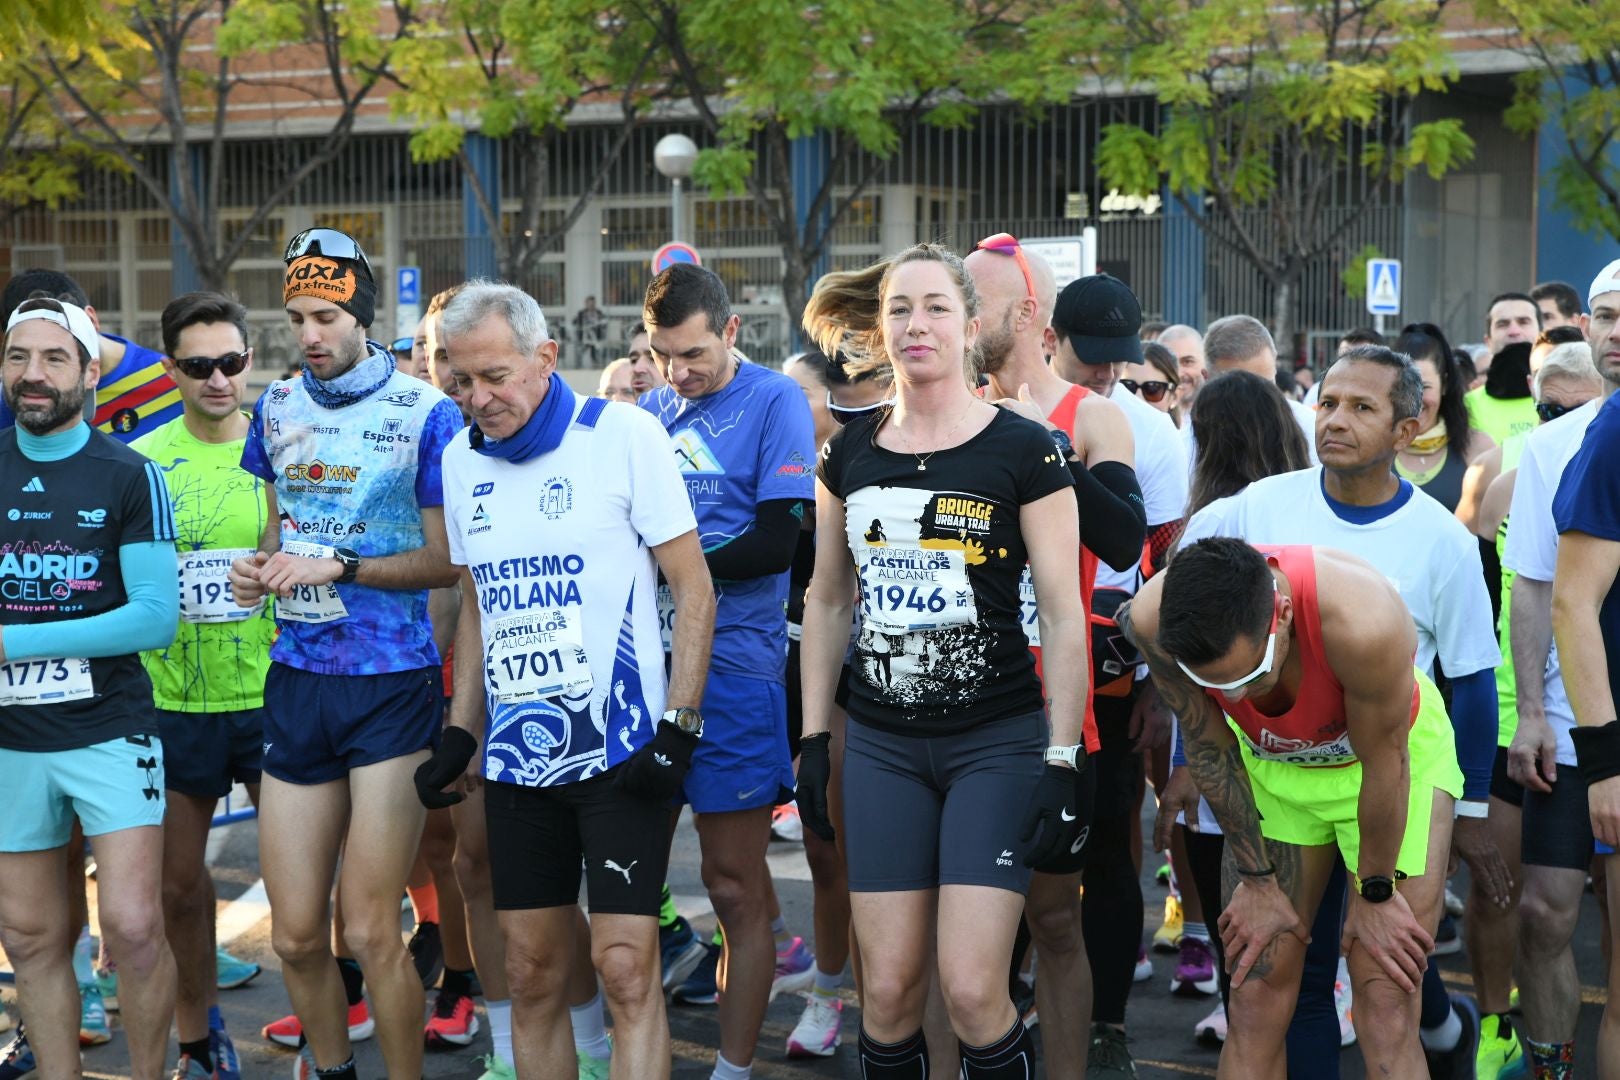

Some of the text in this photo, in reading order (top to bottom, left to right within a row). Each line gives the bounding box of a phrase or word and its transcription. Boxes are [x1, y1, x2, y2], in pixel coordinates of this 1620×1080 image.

[303, 280, 346, 294] x-treme
[363, 430, 411, 444] Espots
[285, 459, 357, 485] CROWN
[543, 477, 556, 487] ANA
[563, 478, 573, 511] ALICANTE
[23, 511, 52, 519] ZURICH
[936, 498, 994, 520] BRUGGE
[468, 525, 491, 536] Alicante
[935, 514, 990, 531] URBAN TRAIL
[870, 548, 934, 559] CARRERA
[0, 552, 99, 580] ADRID
[185, 559, 231, 569] CASTIL
[472, 554, 585, 586] ATLETISMO
[870, 557, 950, 569] CASTILLOS
[878, 569, 939, 581] ALICANTE
[1, 580, 71, 601] CIELO
[192, 583, 233, 605] 195
[289, 584, 320, 603] 981
[482, 580, 582, 614] APOLANA
[873, 585, 946, 613] 1946
[956, 590, 967, 607] 5K
[6, 603, 55, 611] MARATHON
[495, 613, 551, 629] CARRERA
[495, 620, 568, 640] CASTILLOS
[502, 632, 557, 650] ALICANTE
[574, 648, 587, 664] 5K
[1, 658, 68, 686] 1773
[501, 649, 563, 681] 1701
